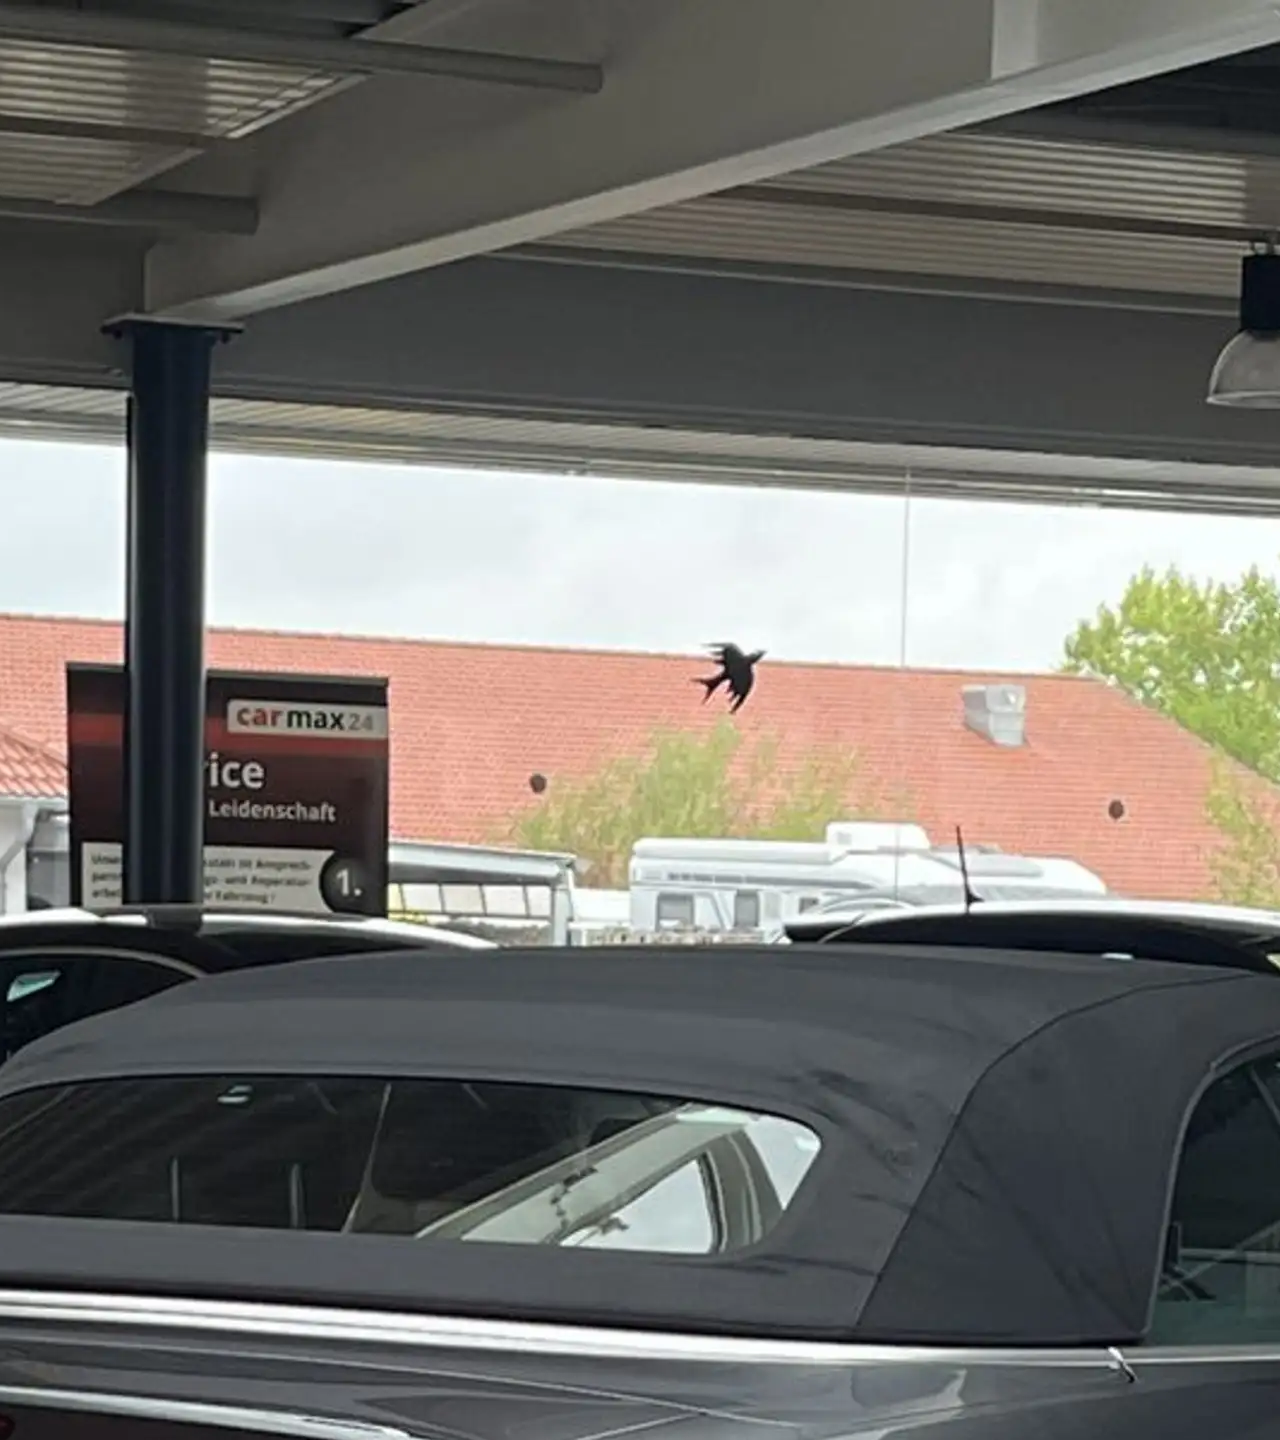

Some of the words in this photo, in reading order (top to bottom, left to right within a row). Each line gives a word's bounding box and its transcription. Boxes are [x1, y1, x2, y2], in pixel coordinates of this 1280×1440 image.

[236, 706, 373, 731] carmax24
[205, 752, 264, 788] ice
[208, 801, 337, 823] Leidenschaft
[336, 868, 362, 896] 1.
